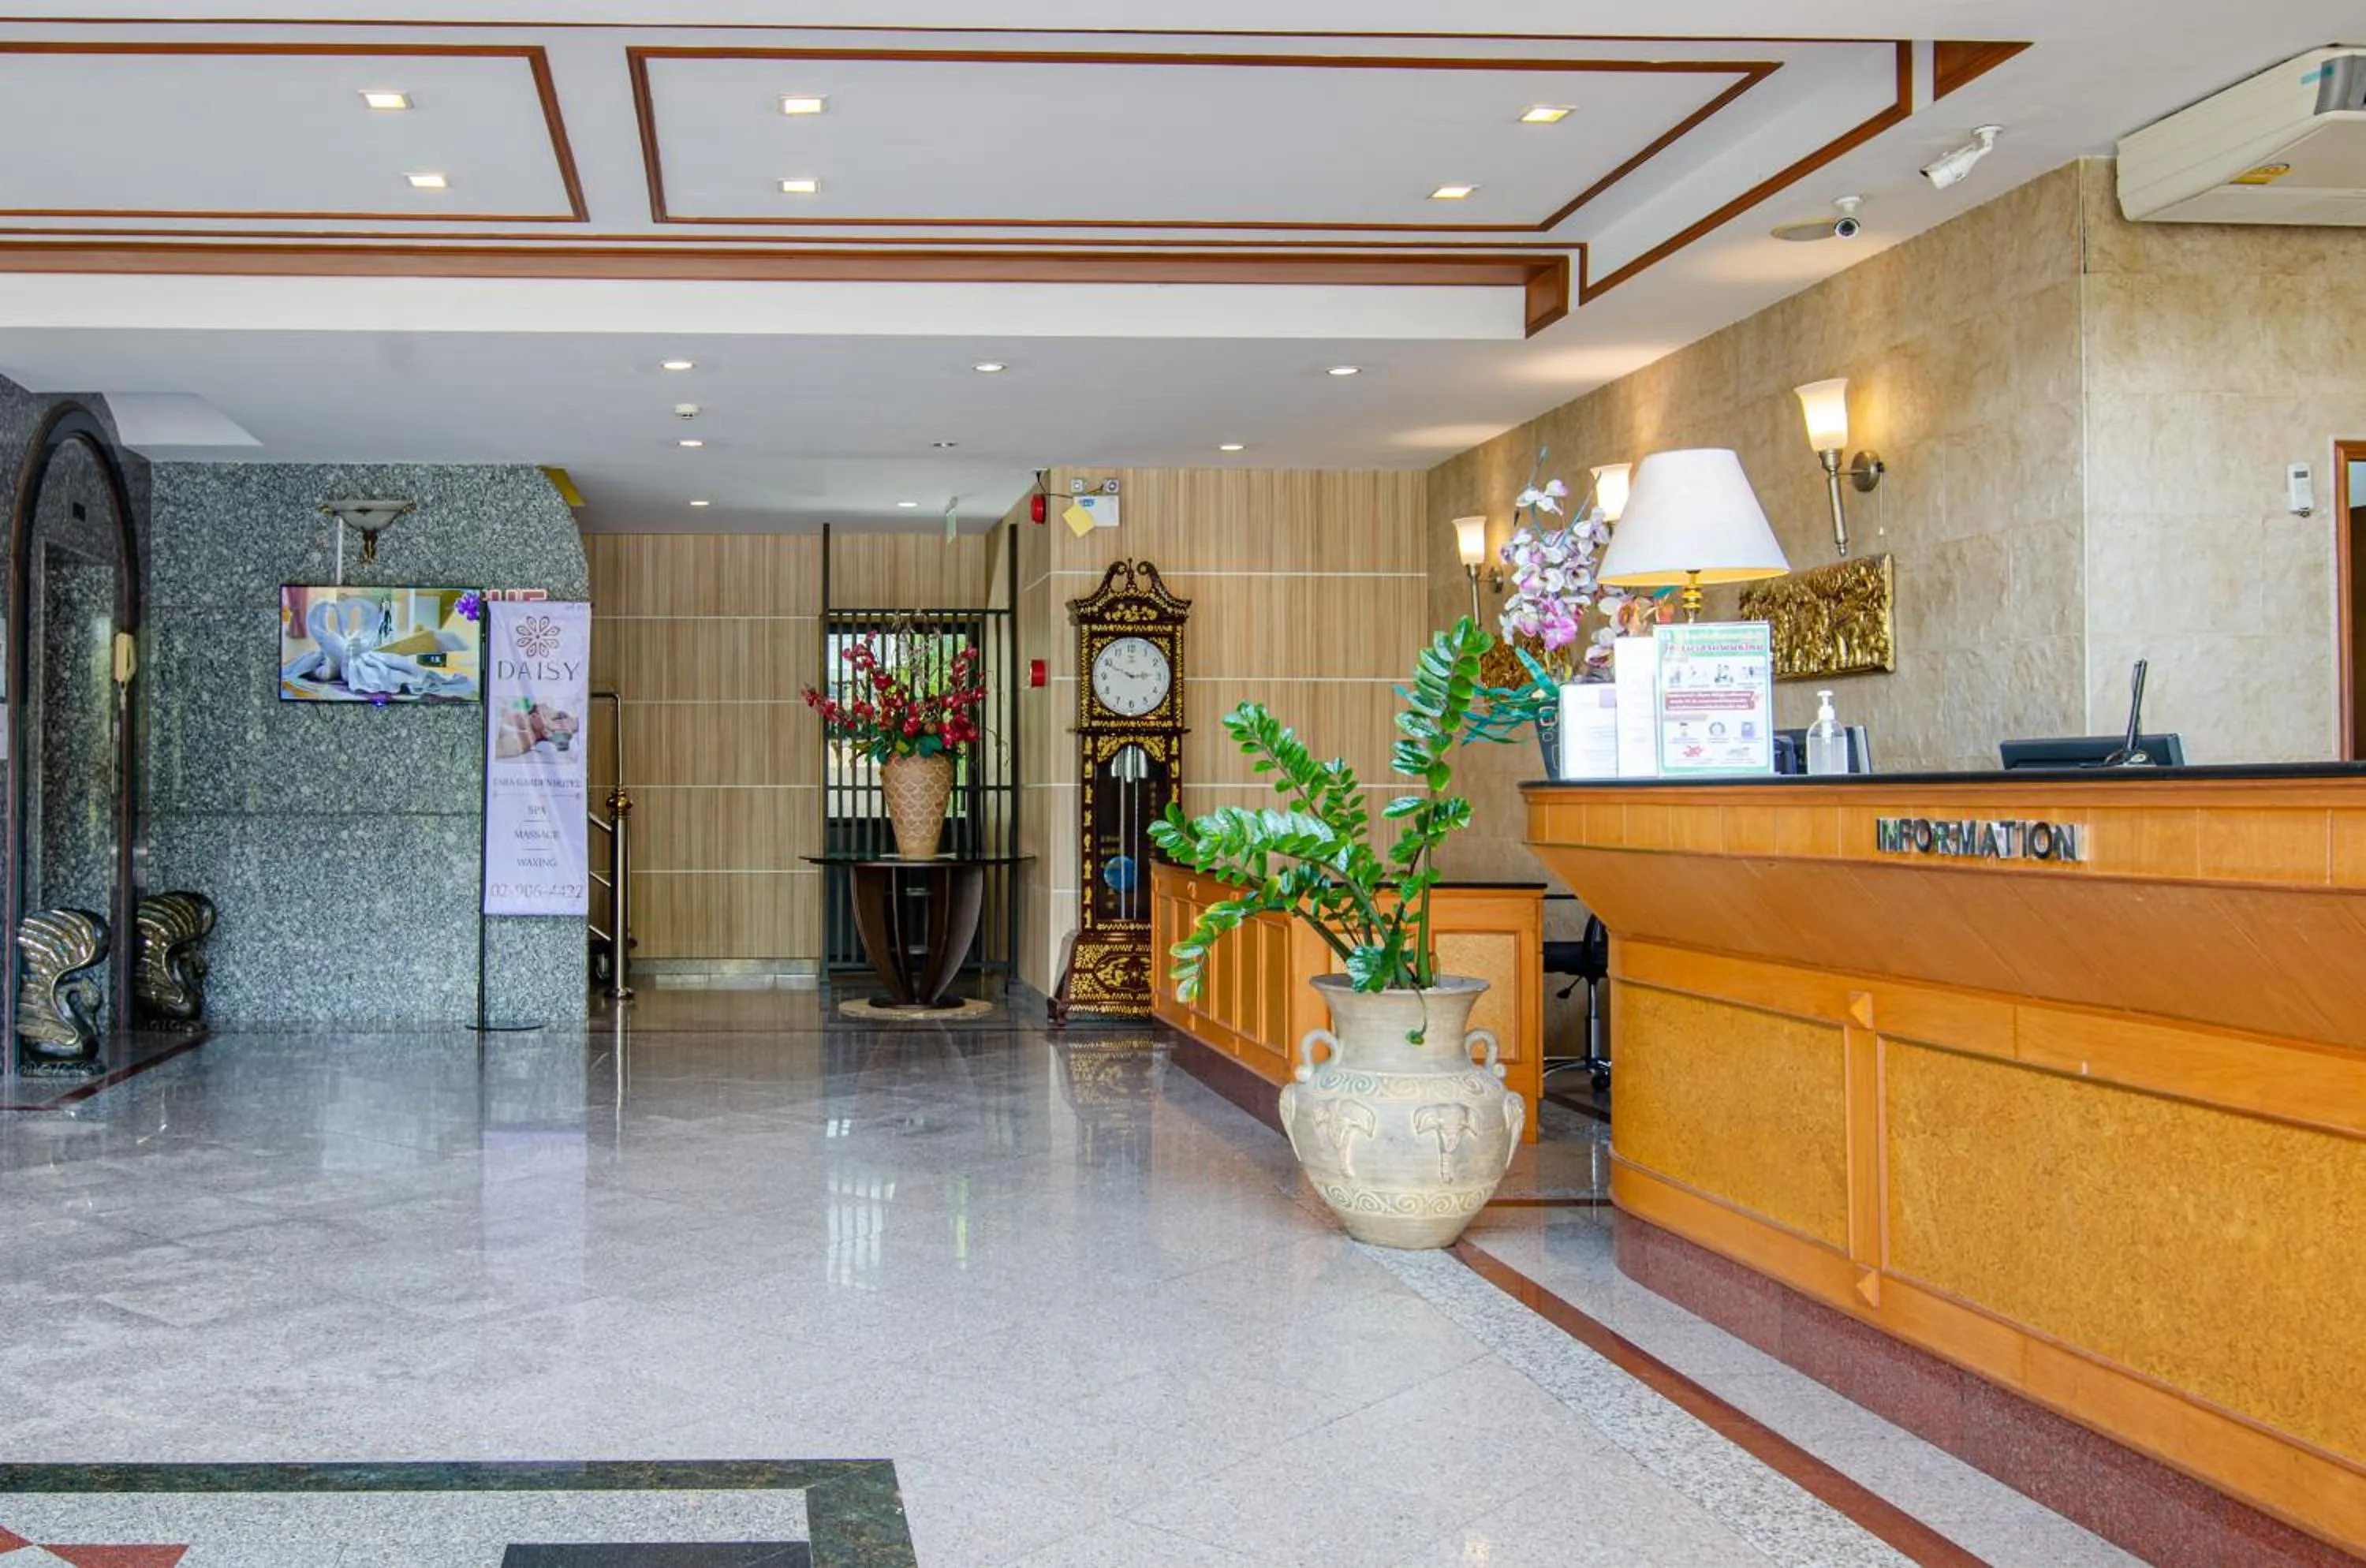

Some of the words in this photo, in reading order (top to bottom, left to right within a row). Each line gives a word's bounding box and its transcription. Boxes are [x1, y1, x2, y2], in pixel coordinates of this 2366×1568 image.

[1127, 644, 1136, 653] 12
[498, 661, 580, 681] DAISY
[528, 805, 547, 815] SPA
[514, 830, 559, 839] MASSAGE
[1876, 818, 2086, 861] INFORMATION
[517, 857, 557, 868] WAXING
